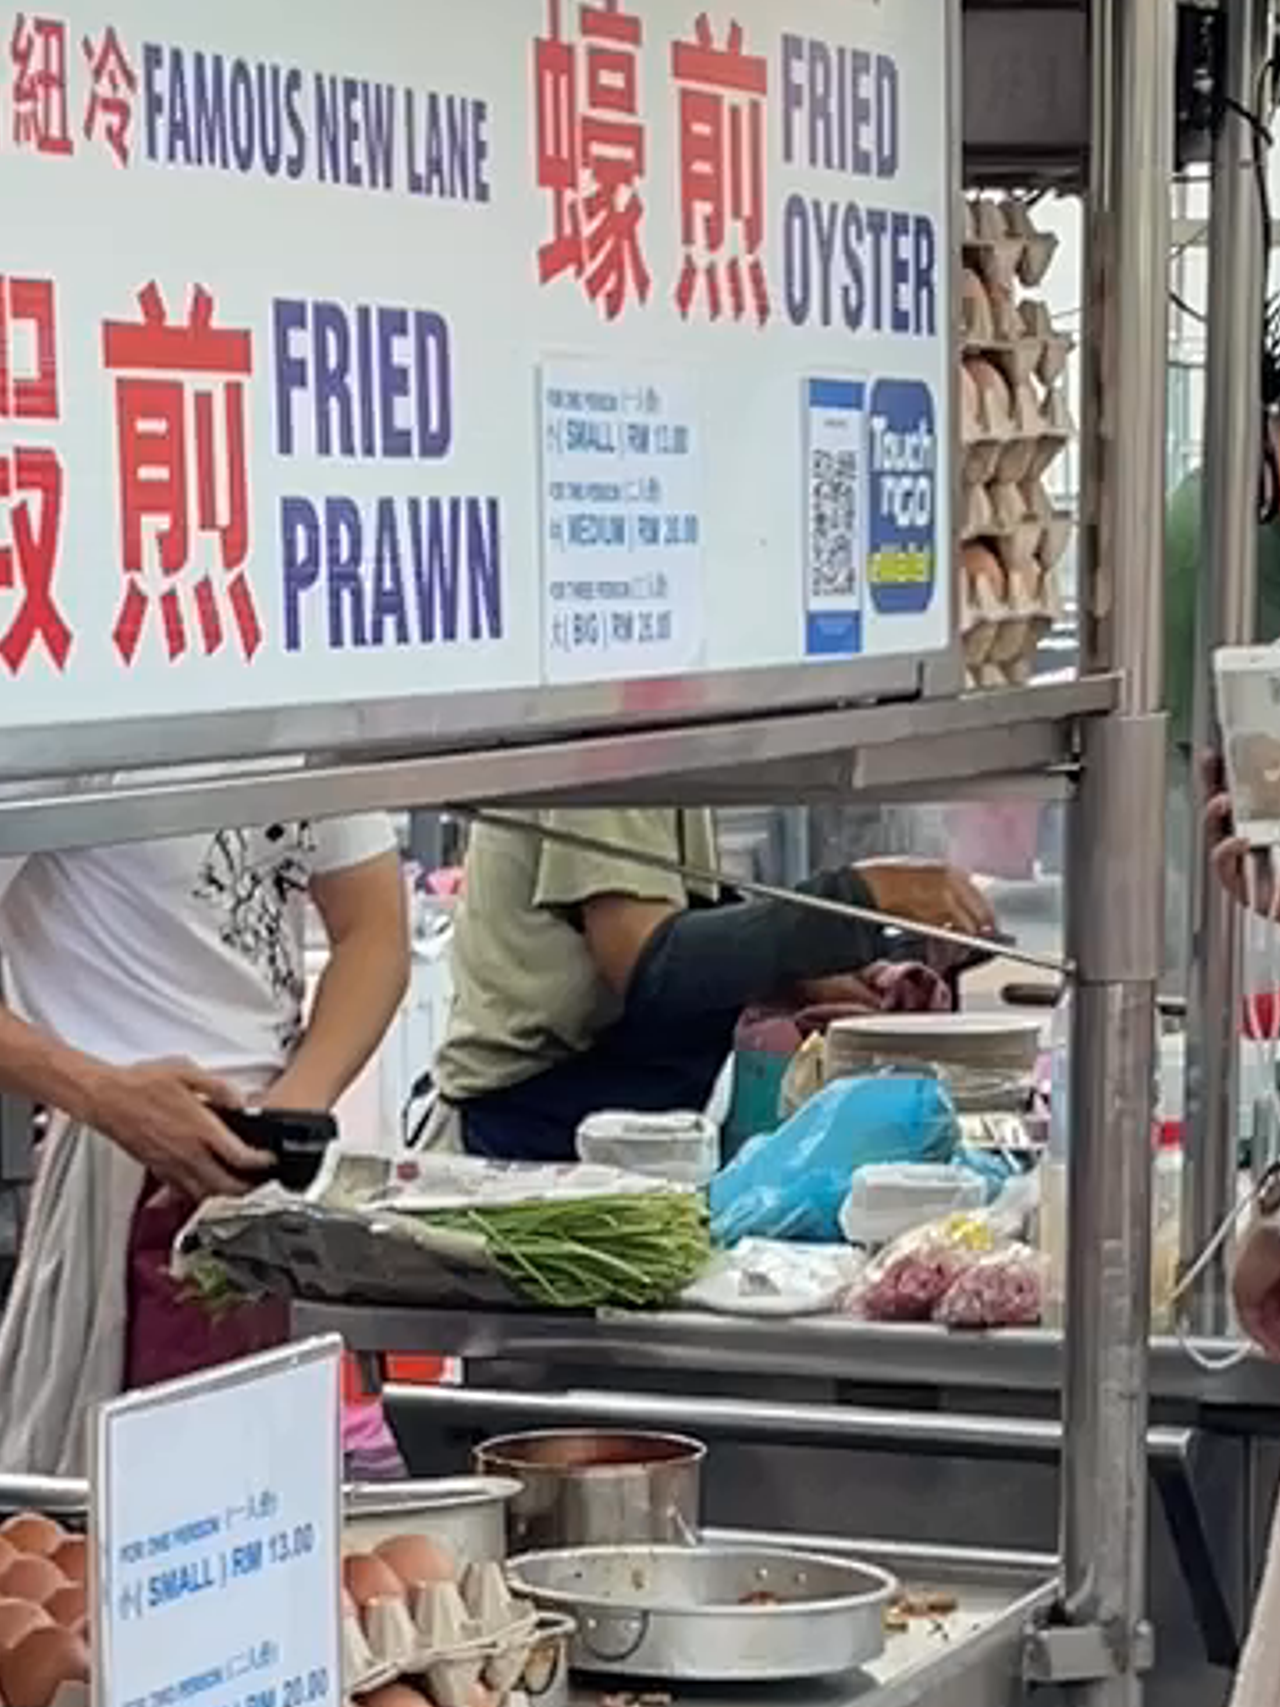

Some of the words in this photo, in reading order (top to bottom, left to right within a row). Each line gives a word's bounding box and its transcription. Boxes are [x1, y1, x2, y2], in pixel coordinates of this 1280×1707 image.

[142, 43, 308, 182] FAMOUS
[314, 71, 395, 191] NEW
[404, 87, 491, 203] LANE
[781, 33, 900, 180] FRIED
[783, 193, 938, 337] OYSTER
[272, 297, 452, 459] FRIED
[280, 495, 503, 653] PRAWN
[148, 1557, 215, 1608] SMALL
[231, 1541, 263, 1578] RM
